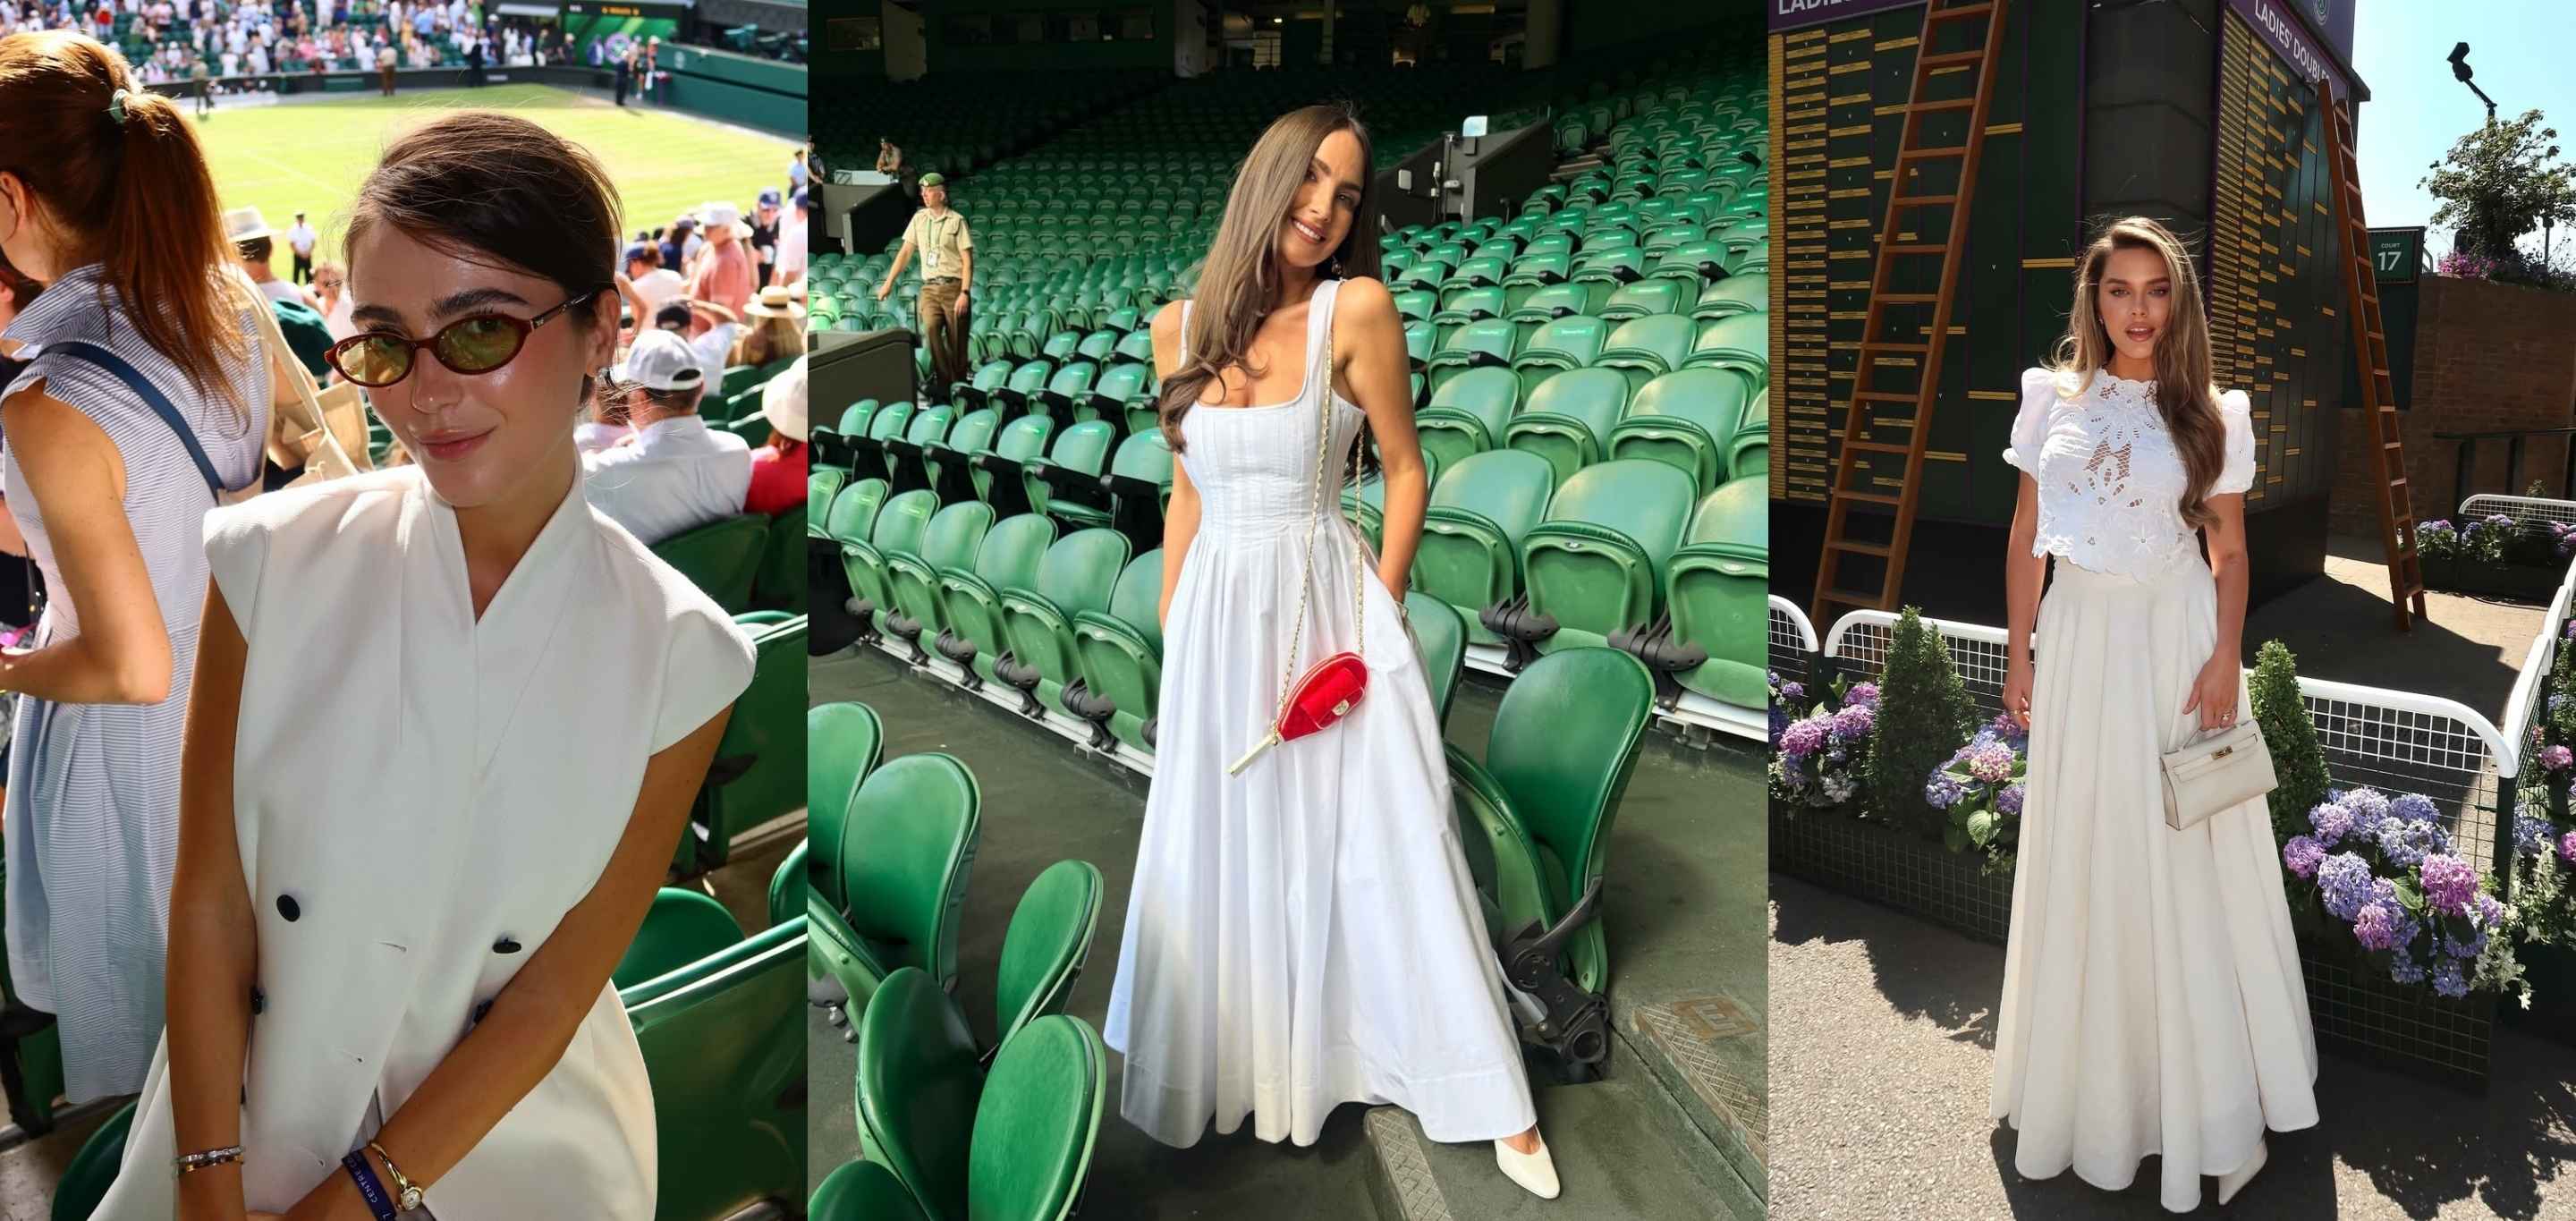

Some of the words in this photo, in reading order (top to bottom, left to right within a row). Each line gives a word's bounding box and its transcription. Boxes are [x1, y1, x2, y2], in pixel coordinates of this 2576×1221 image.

[1778, 0, 1852, 15] LAD
[2255, 0, 2292, 49] LADIES'
[2377, 250, 2402, 271] 17
[355, 1169, 378, 1203] CENTRE
